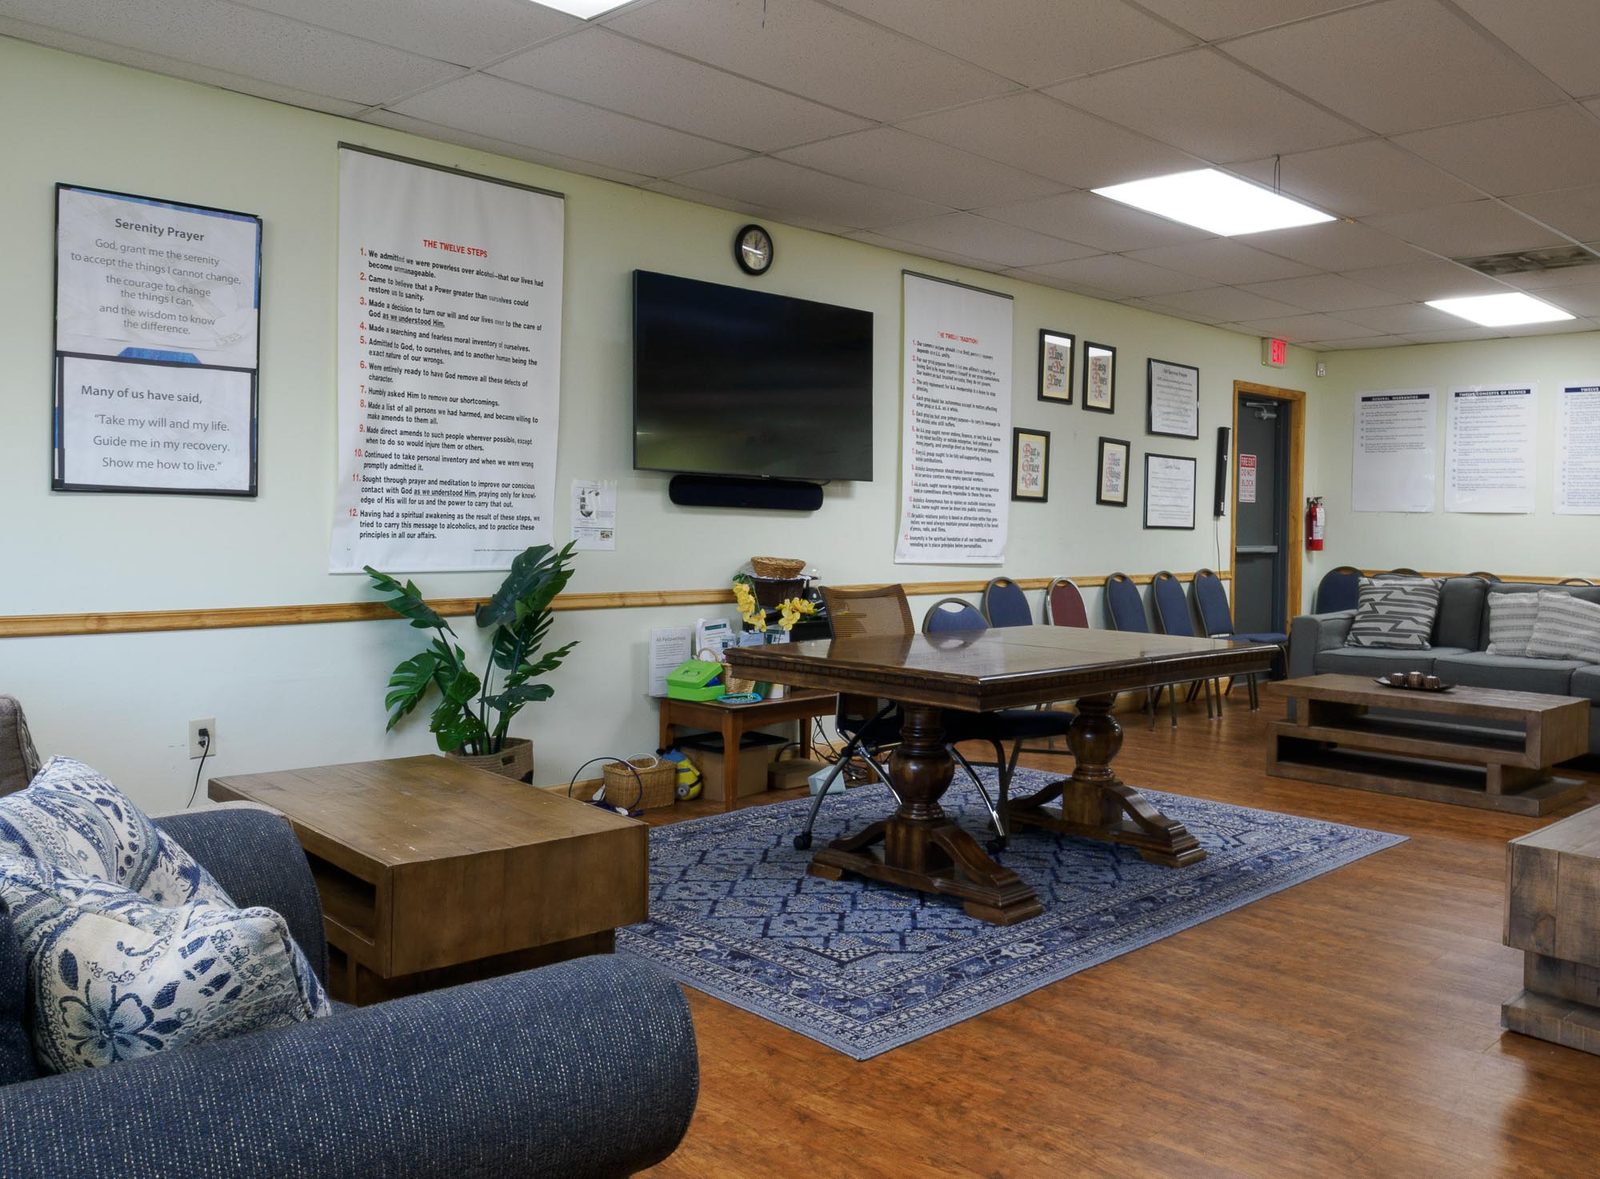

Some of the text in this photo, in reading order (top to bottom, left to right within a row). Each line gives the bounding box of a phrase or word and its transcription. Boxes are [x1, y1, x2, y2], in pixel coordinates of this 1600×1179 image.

[115, 218, 205, 242] Serenity Prayer
[120, 244, 146, 255] grant
[148, 249, 165, 258] me
[166, 249, 182, 260] the
[183, 254, 220, 268] serenity
[424, 239, 488, 258] THE TWELVE STEPS
[71, 252, 82, 262] to
[83, 255, 116, 268] accept
[118, 259, 133, 269] the
[136, 261, 166, 275] things
[172, 268, 204, 279] cannot
[368, 260, 393, 272] become
[415, 260, 534, 285] were powerless lives
[106, 275, 211, 298] the courage to change
[368, 274, 386, 284] Came
[415, 282, 428, 291] that
[434, 285, 452, 295] Power
[453, 290, 474, 298] greater
[475, 292, 488, 301] than
[368, 286, 390, 295] restore
[121, 289, 136, 299] the
[138, 291, 170, 304] things
[99, 305, 216, 326] and the wisdom to know
[398, 315, 432, 326] understood
[423, 307, 436, 316] turn
[481, 316, 494, 324] lives
[124, 319, 191, 335] the difference.
[431, 332, 453, 342] fearless
[472, 338, 498, 349] inventory
[423, 356, 445, 365] wrongs.
[473, 353, 527, 366] another being
[404, 368, 422, 377] ready
[430, 370, 444, 378] have
[81, 385, 203, 405] Many of us have said,
[387, 389, 406, 398] asked
[460, 396, 500, 408] shortcomings.
[386, 403, 396, 411] list
[414, 407, 437, 415] persons
[128, 418, 146, 429] my
[169, 420, 190, 430] and
[193, 422, 209, 433] my
[211, 422, 230, 432] life.
[381, 414, 429, 424] amends them
[380, 427, 398, 435] direct
[445, 433, 465, 441] people
[466, 434, 492, 442] wherever
[93, 435, 231, 454] Guide me in my recovery.
[366, 436, 379, 444] when
[425, 440, 440, 449] injure
[442, 441, 456, 449] them
[465, 443, 485, 451] others.
[102, 457, 134, 468] Show
[136, 460, 154, 469] me
[157, 459, 181, 470] how
[183, 461, 195, 471] to
[365, 450, 393, 459] Continued
[402, 453, 416, 461] take
[442, 455, 468, 465] inventory
[363, 462, 417, 471] promptly admitted
[362, 474, 500, 489] Sought through prayer meditation improve
[361, 485, 512, 500] contact with understood praying only
[360, 495, 376, 504] edge
[475, 501, 489, 509] carry
[360, 509, 382, 519] Having
[401, 511, 425, 520] spiritual
[425, 512, 456, 521] awakening
[360, 520, 375, 528] tried
[384, 522, 400, 530] carry
[497, 524, 519, 532] practice
[360, 531, 390, 540] principles
